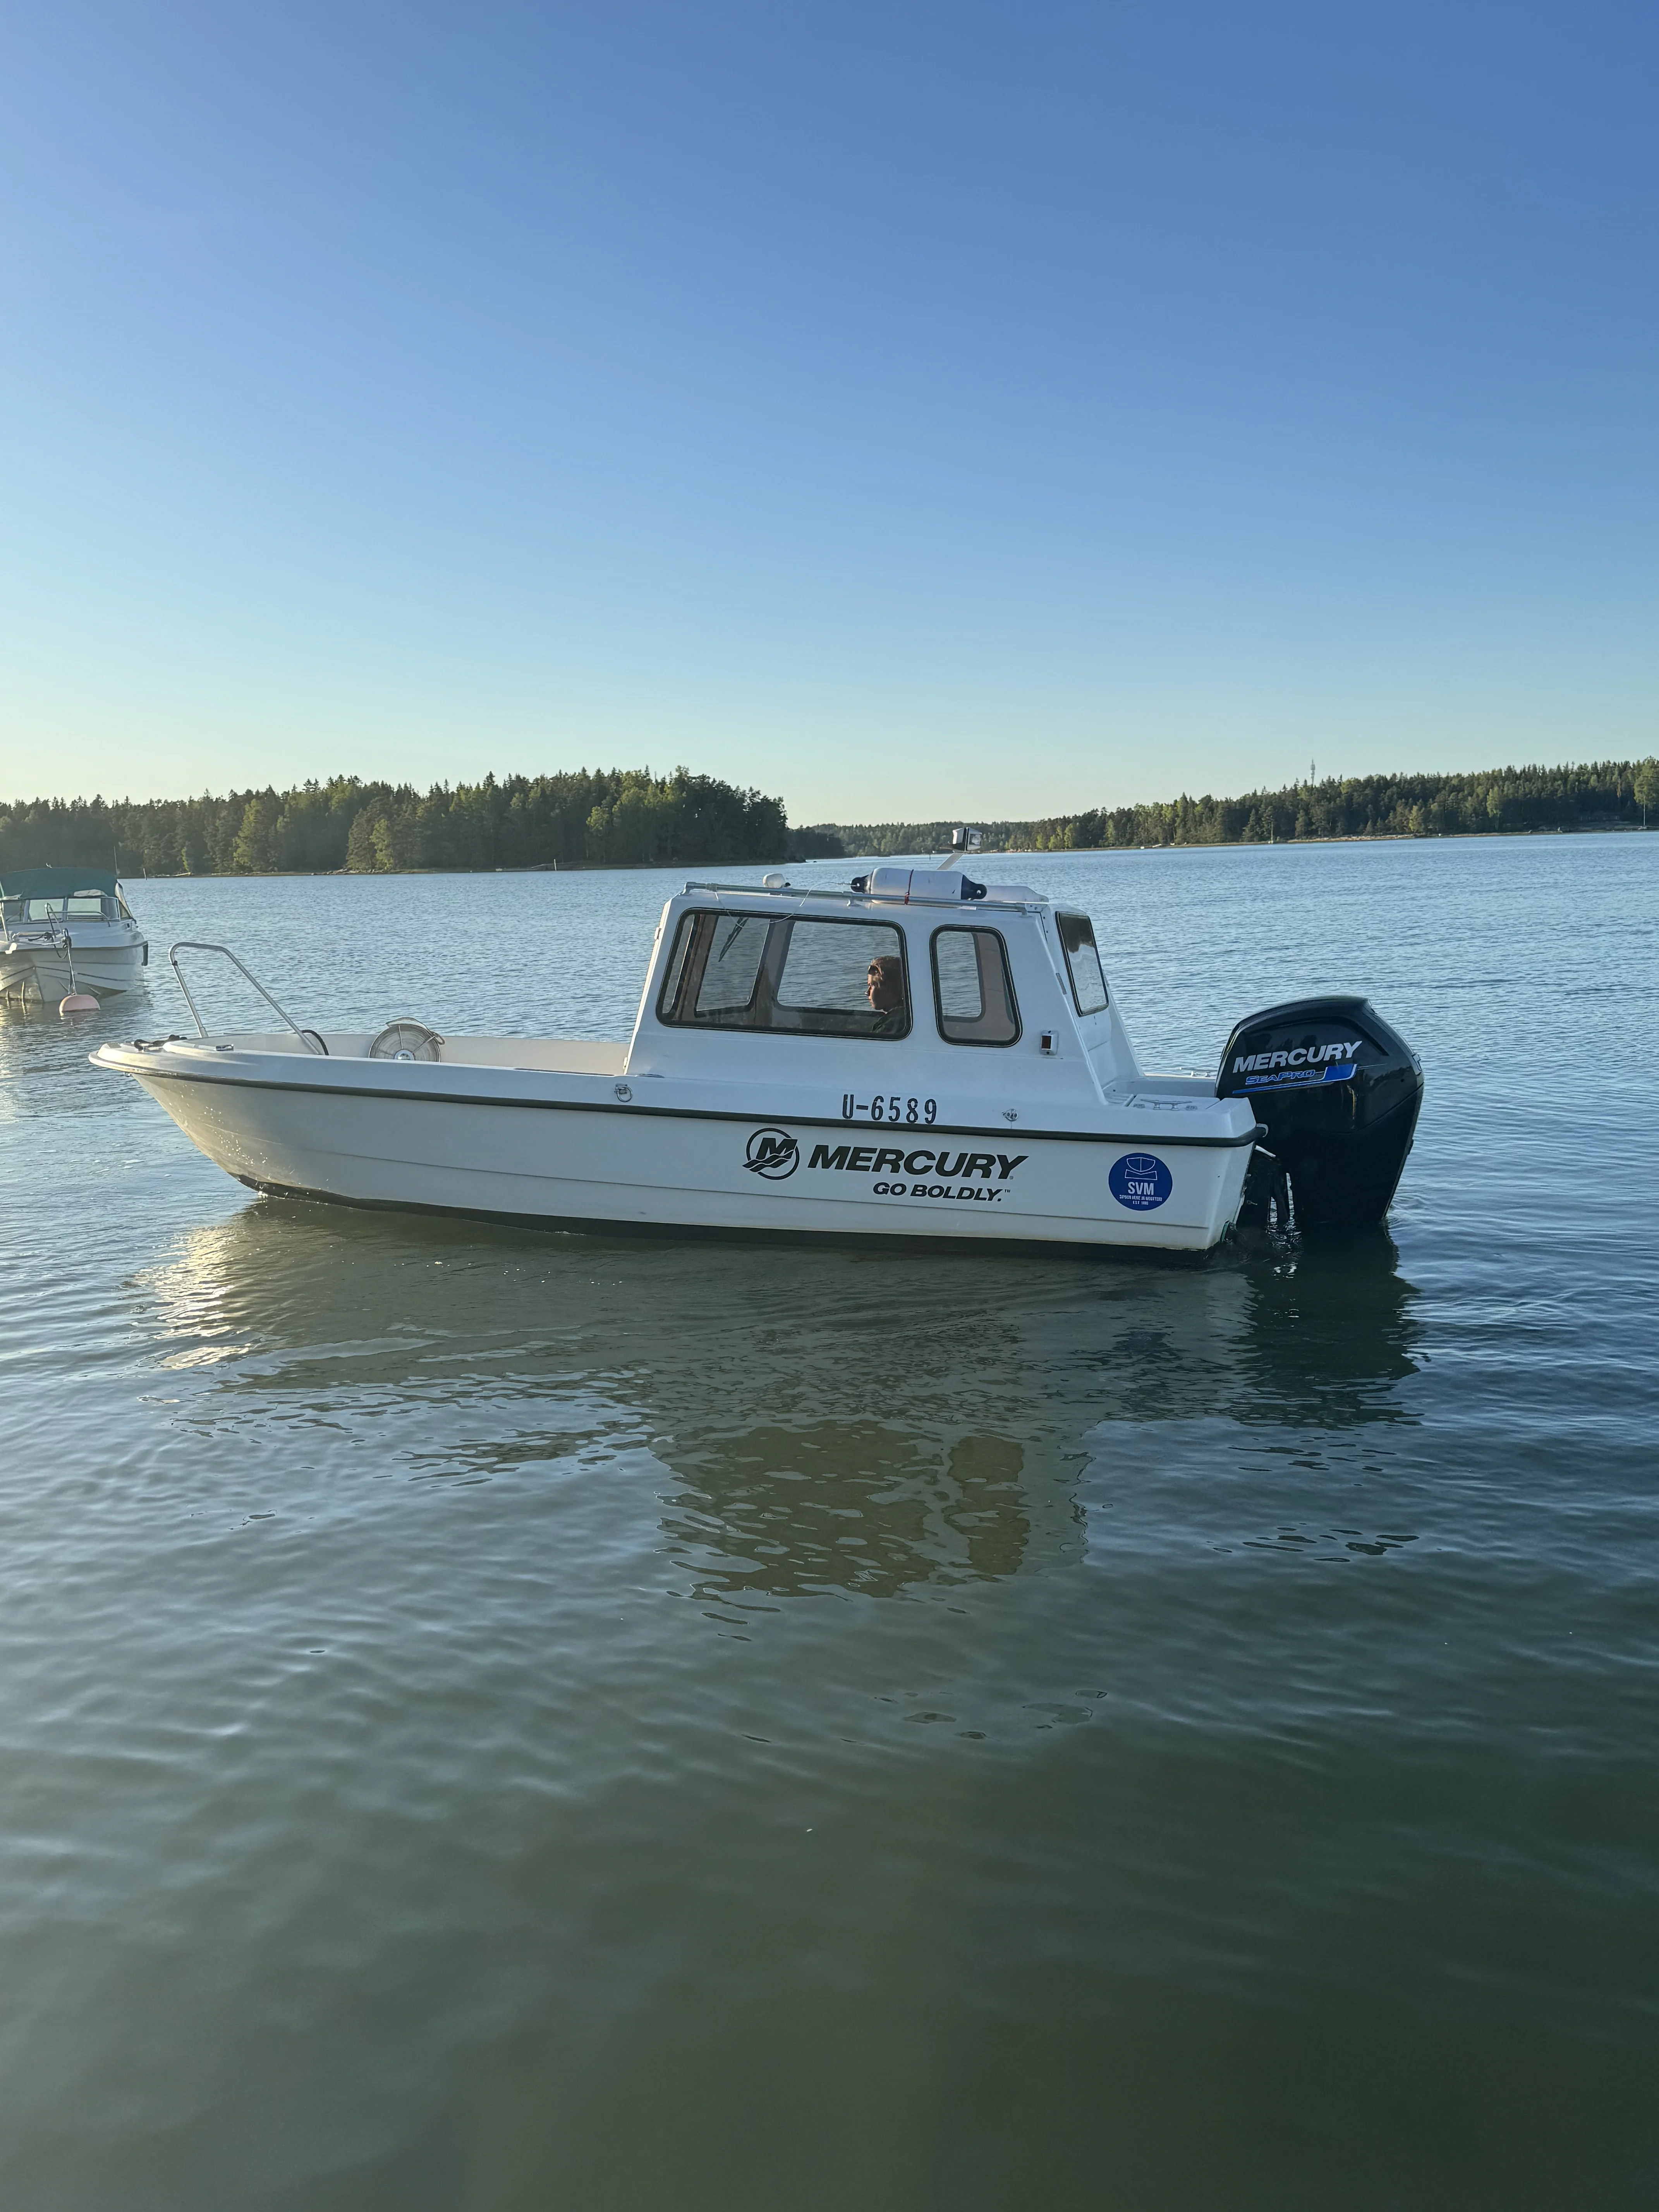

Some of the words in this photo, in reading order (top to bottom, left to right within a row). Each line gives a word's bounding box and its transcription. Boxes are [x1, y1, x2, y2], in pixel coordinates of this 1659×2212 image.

[1233, 1041, 1363, 1073] MERCURY
[842, 1094, 938, 1124] U-6589
[807, 1144, 1029, 1180] MERCURY
[872, 1182, 907, 1196] GO
[1128, 1182, 1154, 1195] SVM
